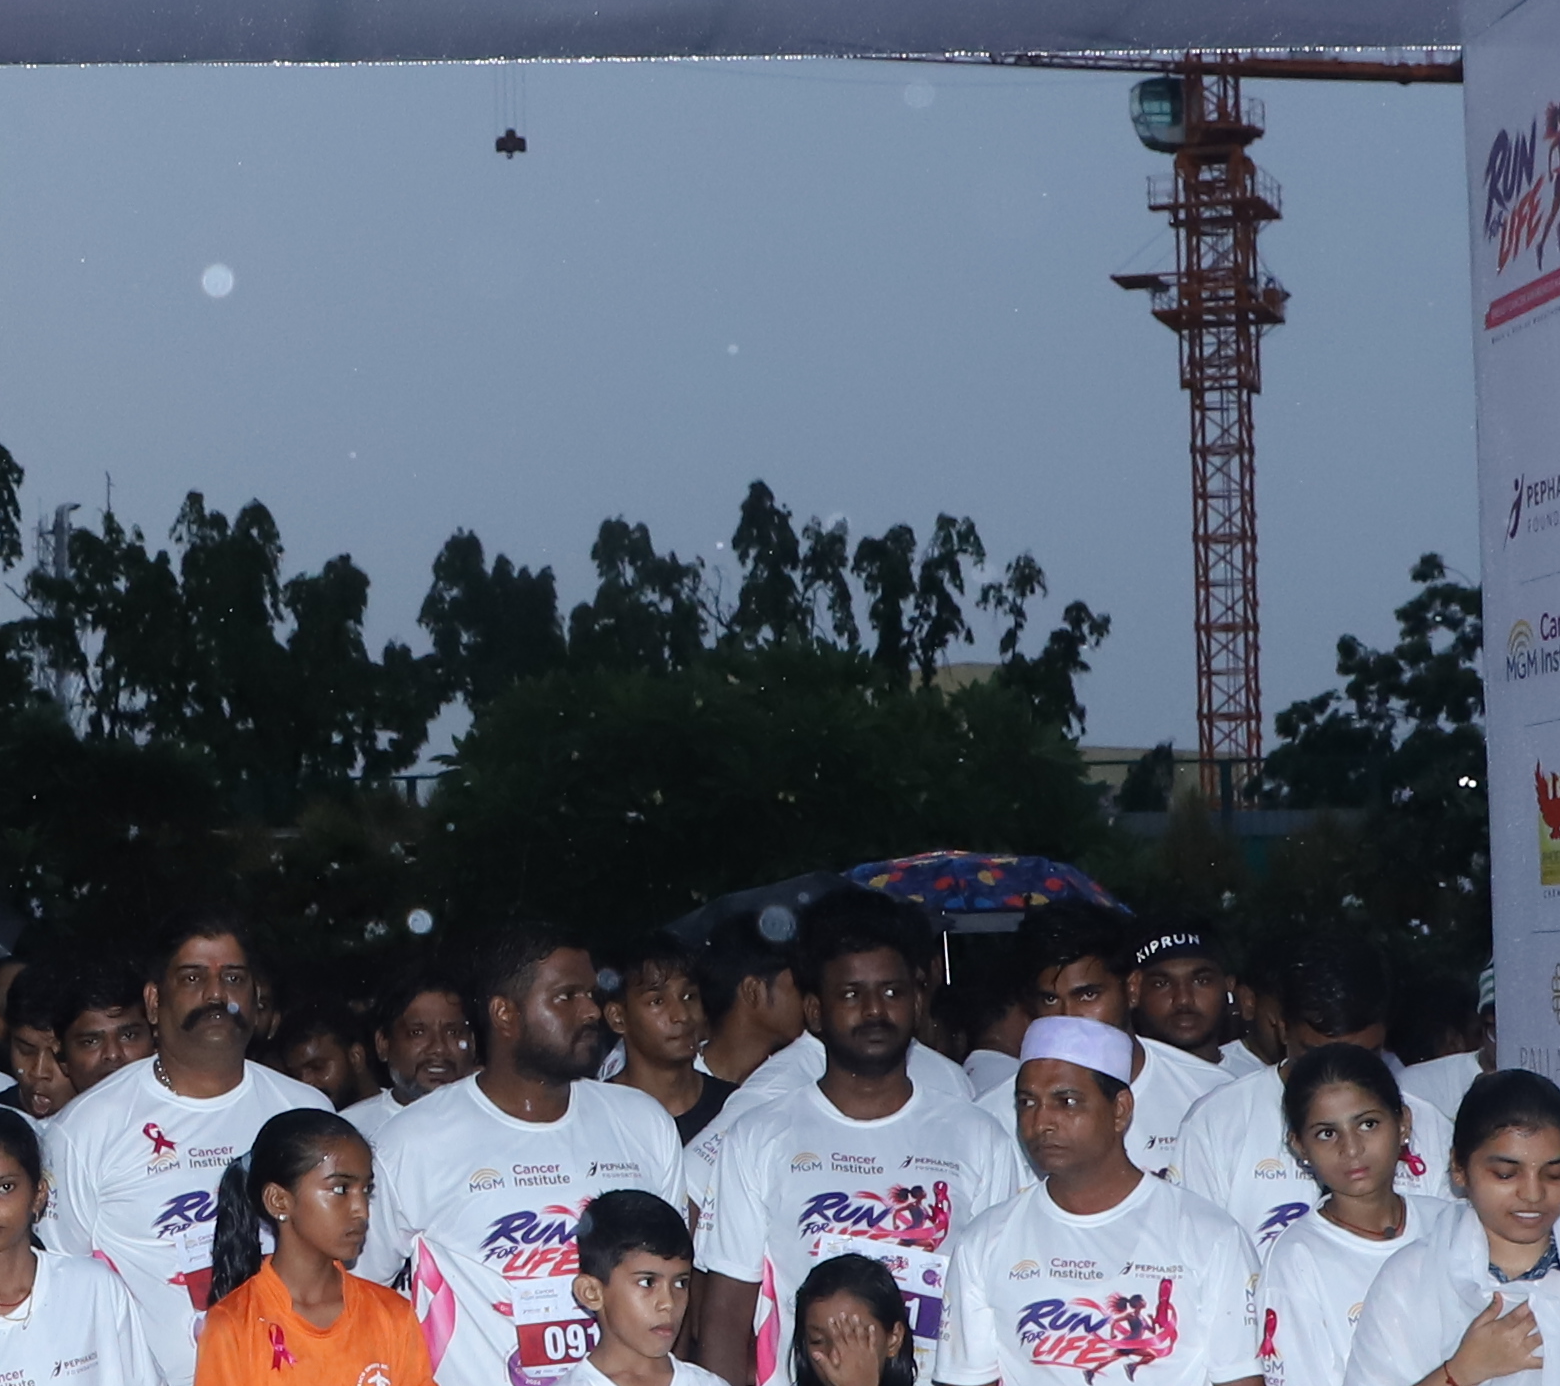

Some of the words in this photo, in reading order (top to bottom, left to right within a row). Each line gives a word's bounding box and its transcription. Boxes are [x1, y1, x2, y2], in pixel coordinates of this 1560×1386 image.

[1506, 648, 1538, 682] MGM
[513, 1164, 560, 1174] Cancer
[469, 1178, 505, 1193] MGM
[514, 1173, 570, 1187] Institute
[1051, 1258, 1097, 1268] Cancer
[1009, 1269, 1040, 1280] MGM
[1049, 1269, 1104, 1280] Institute
[1016, 1299, 1113, 1334] RUN
